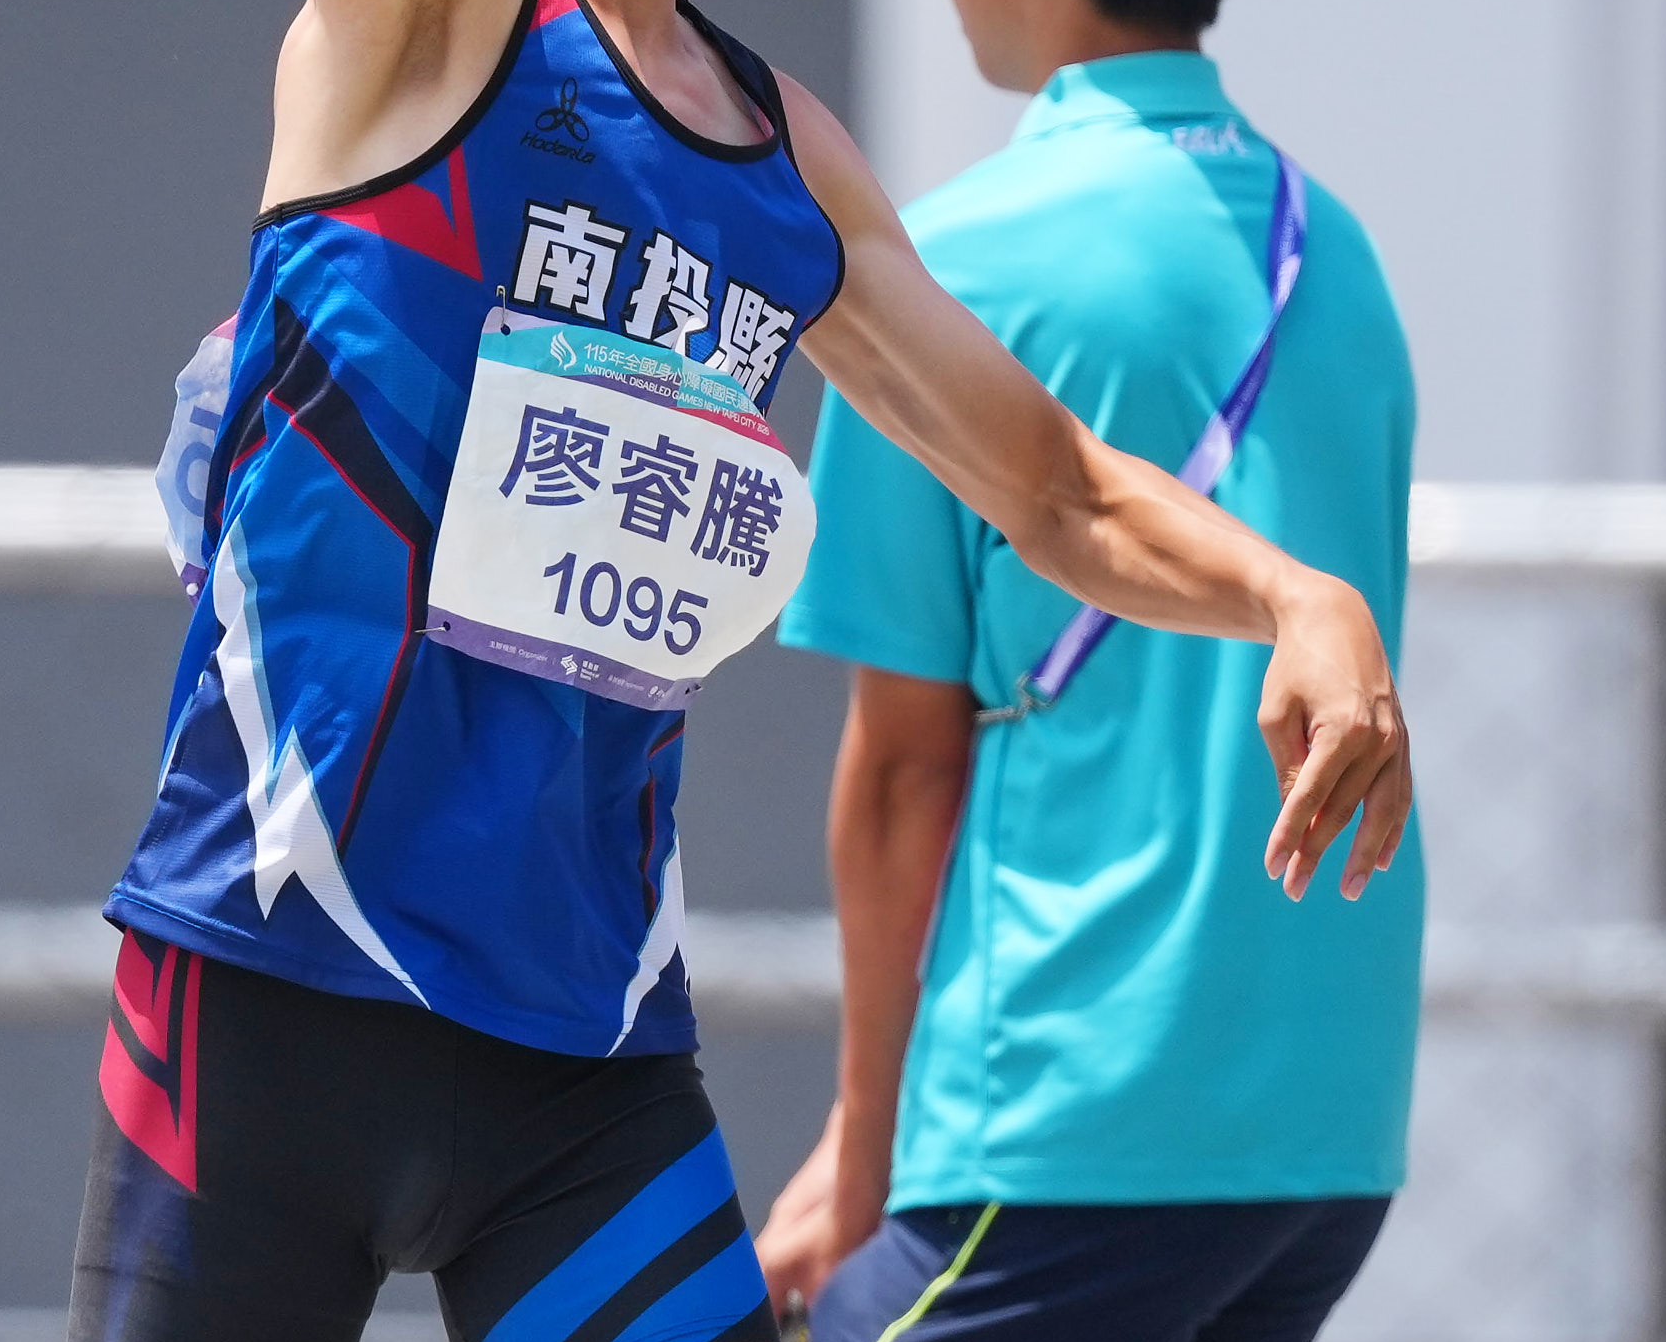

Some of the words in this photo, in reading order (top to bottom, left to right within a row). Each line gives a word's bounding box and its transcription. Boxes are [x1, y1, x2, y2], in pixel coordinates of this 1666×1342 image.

[511, 201, 797, 403] 南投縣
[584, 363, 628, 384] NATIONAL
[629, 376, 672, 398] DISABLED
[671, 389, 704, 409] GAMES
[740, 415, 757, 431] CITY
[498, 403, 783, 578] 廖睿騰
[543, 551, 709, 656] 1095
